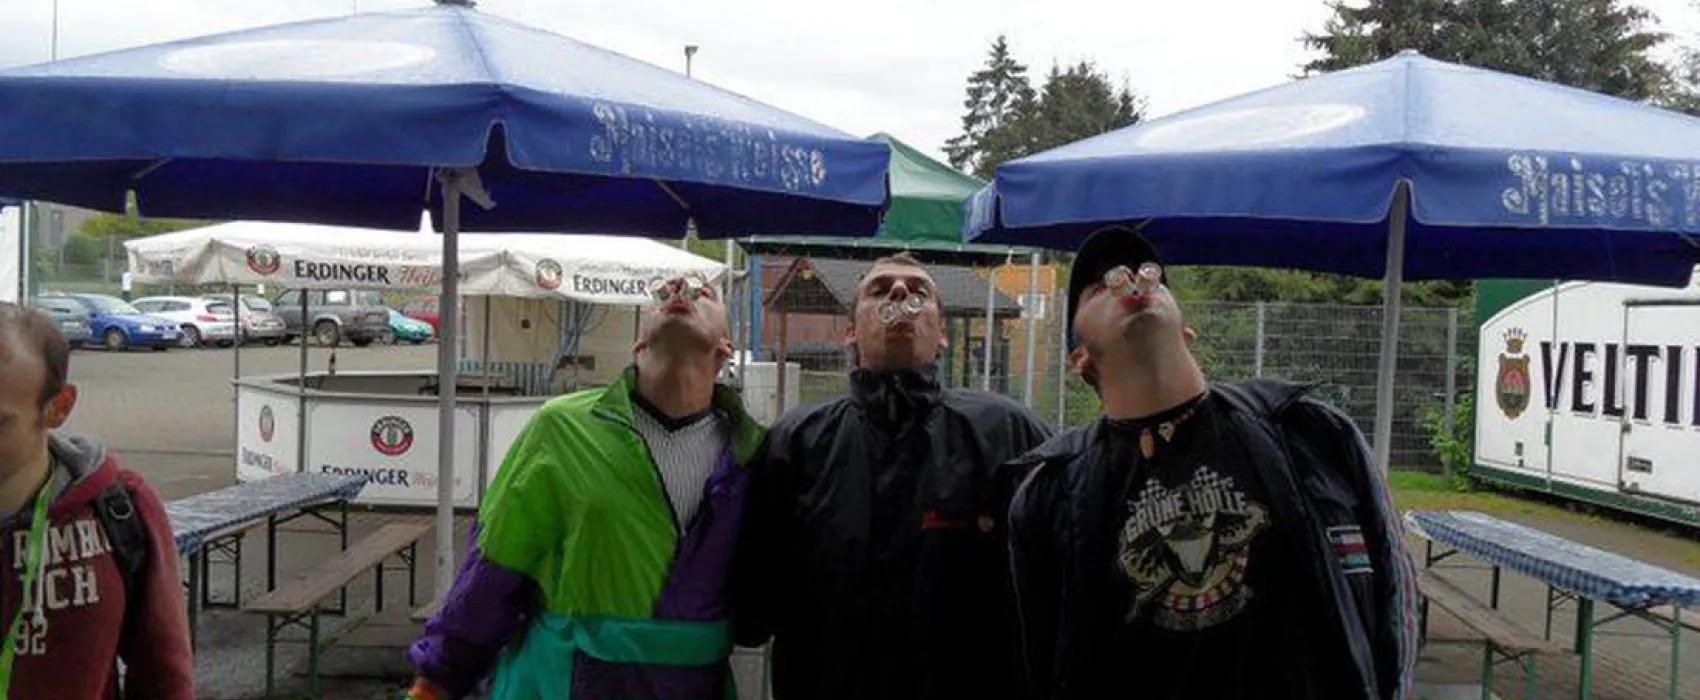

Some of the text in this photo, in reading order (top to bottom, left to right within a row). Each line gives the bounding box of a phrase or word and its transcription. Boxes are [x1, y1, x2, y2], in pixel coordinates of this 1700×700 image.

[294, 259, 391, 284] ERDINGER
[573, 275, 649, 297] ERDINGER
[1540, 341, 1700, 428] VELTI
